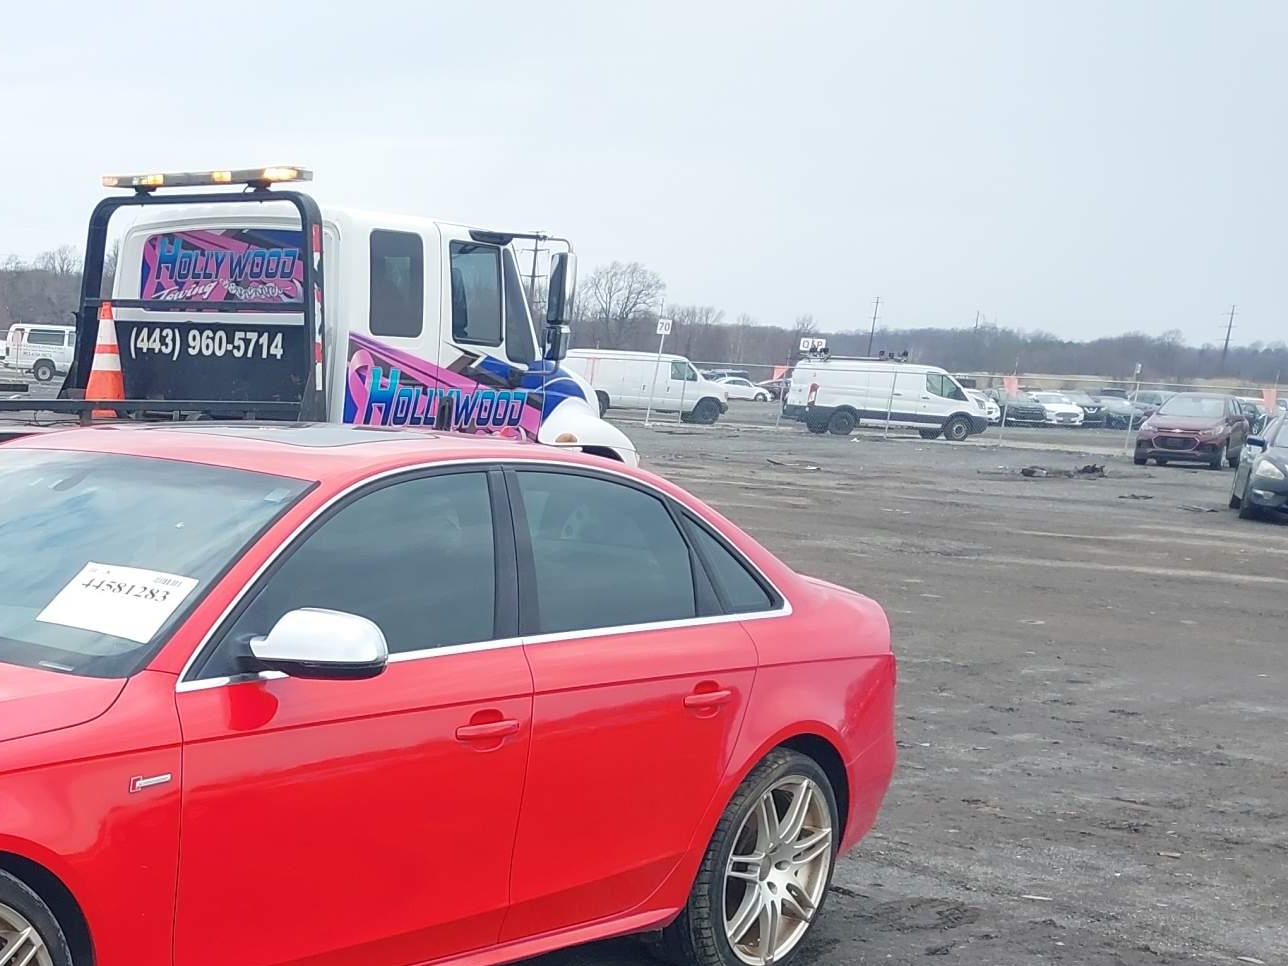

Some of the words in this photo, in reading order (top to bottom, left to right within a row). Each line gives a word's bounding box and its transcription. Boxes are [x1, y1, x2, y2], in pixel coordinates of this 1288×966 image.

[155, 237, 300, 282] HOLLYWOOD
[152, 280, 220, 301] Towing
[659, 321, 671, 332] 70
[130, 327, 181, 361] (443)
[187, 329, 284, 360] 960-5714
[363, 366, 529, 429] HOLLWOOD
[82, 577, 171, 602] 44581283
